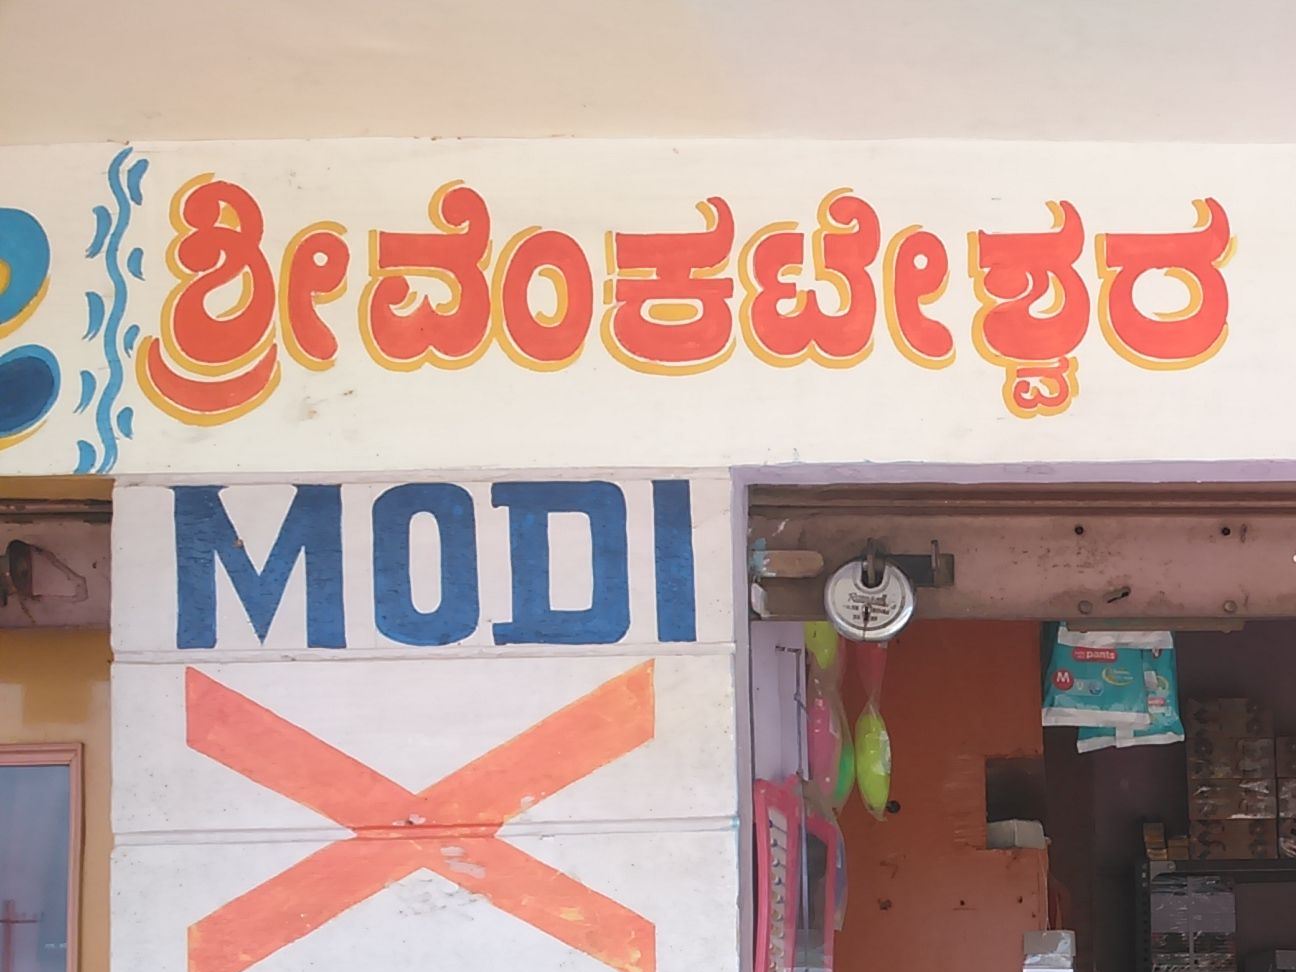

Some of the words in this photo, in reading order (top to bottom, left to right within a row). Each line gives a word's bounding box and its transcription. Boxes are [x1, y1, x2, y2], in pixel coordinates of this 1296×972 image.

[171, 479, 697, 650] MODI
[1086, 649, 1116, 660] pants
[1056, 671, 1071, 683] M
